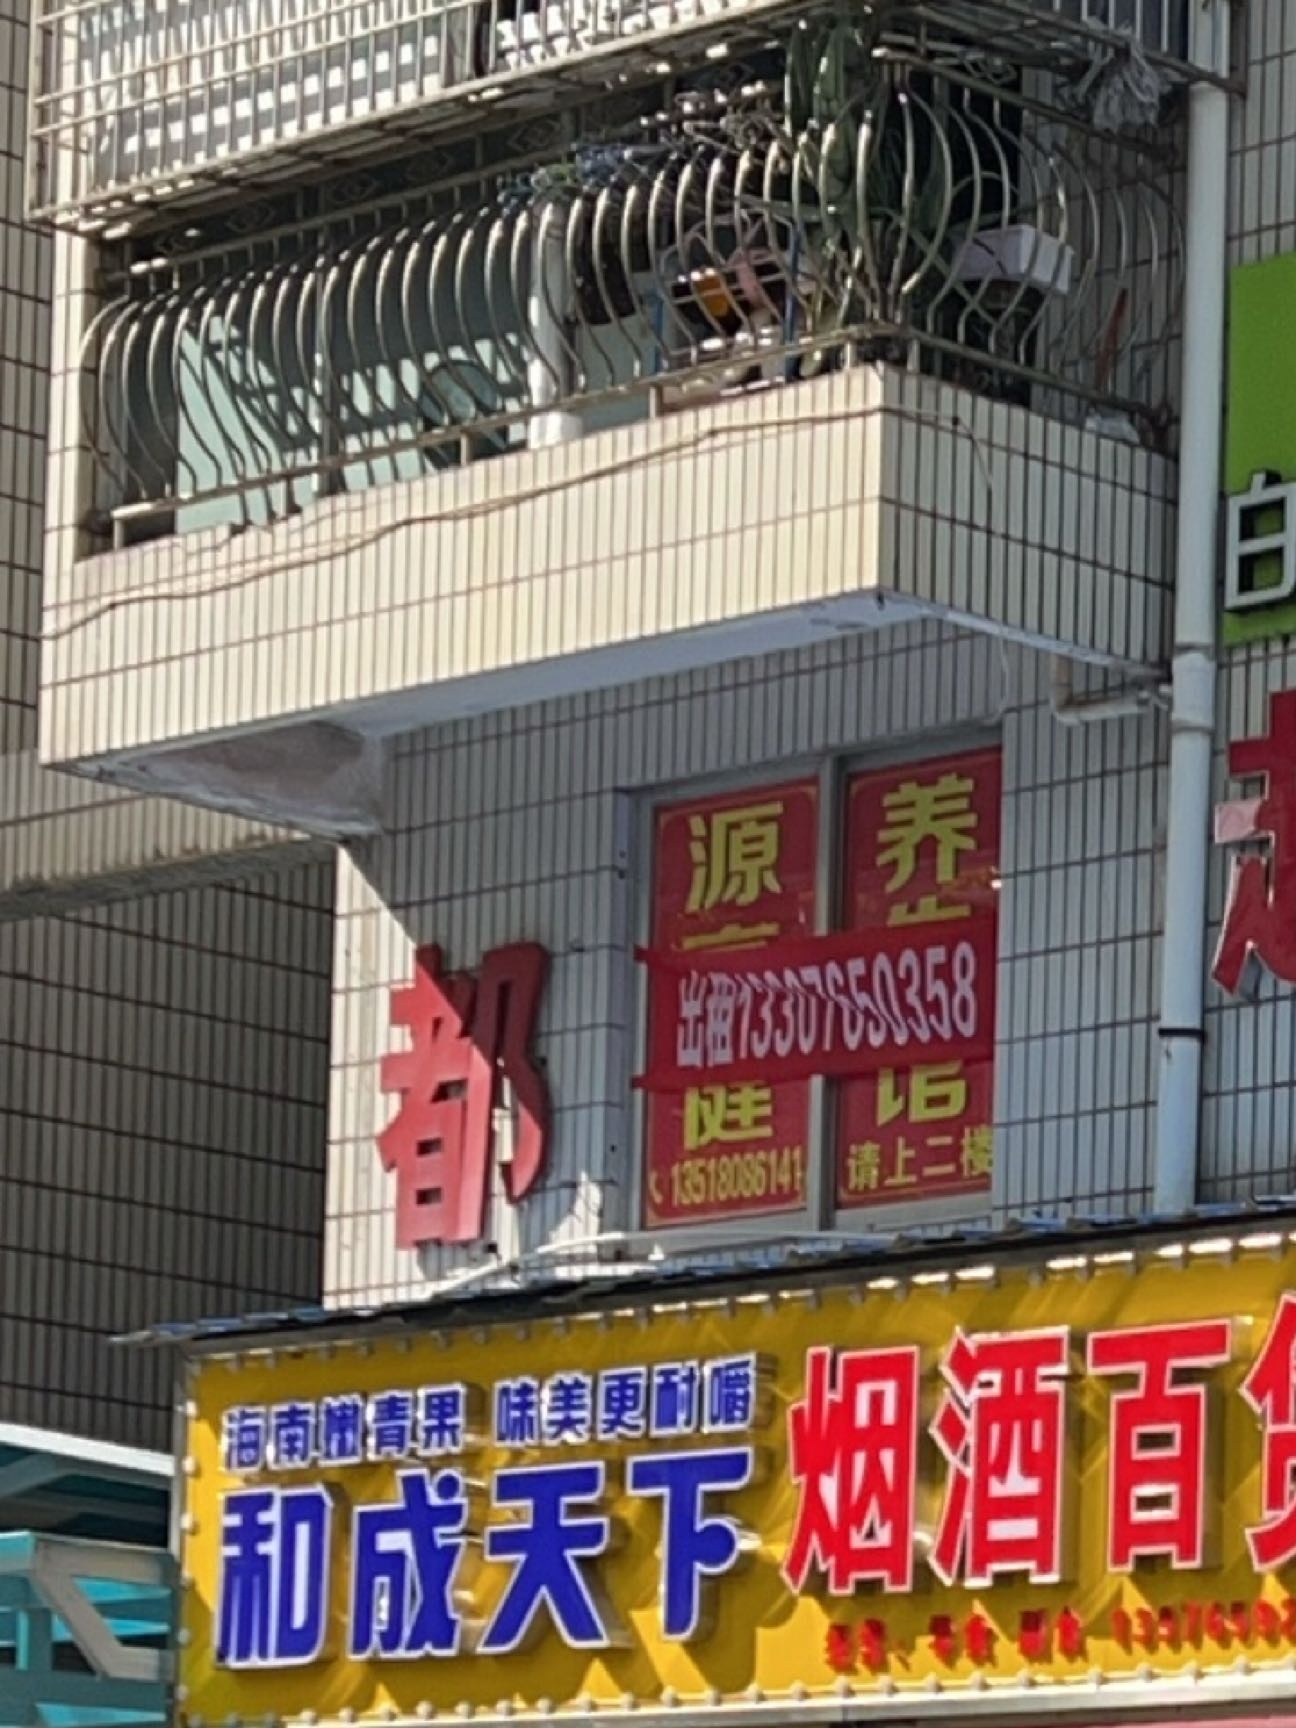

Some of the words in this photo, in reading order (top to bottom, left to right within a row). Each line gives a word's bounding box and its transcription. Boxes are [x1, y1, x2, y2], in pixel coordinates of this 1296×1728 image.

[376, 941, 553, 1250] 都
[215, 1447, 753, 1669] 和成天下
